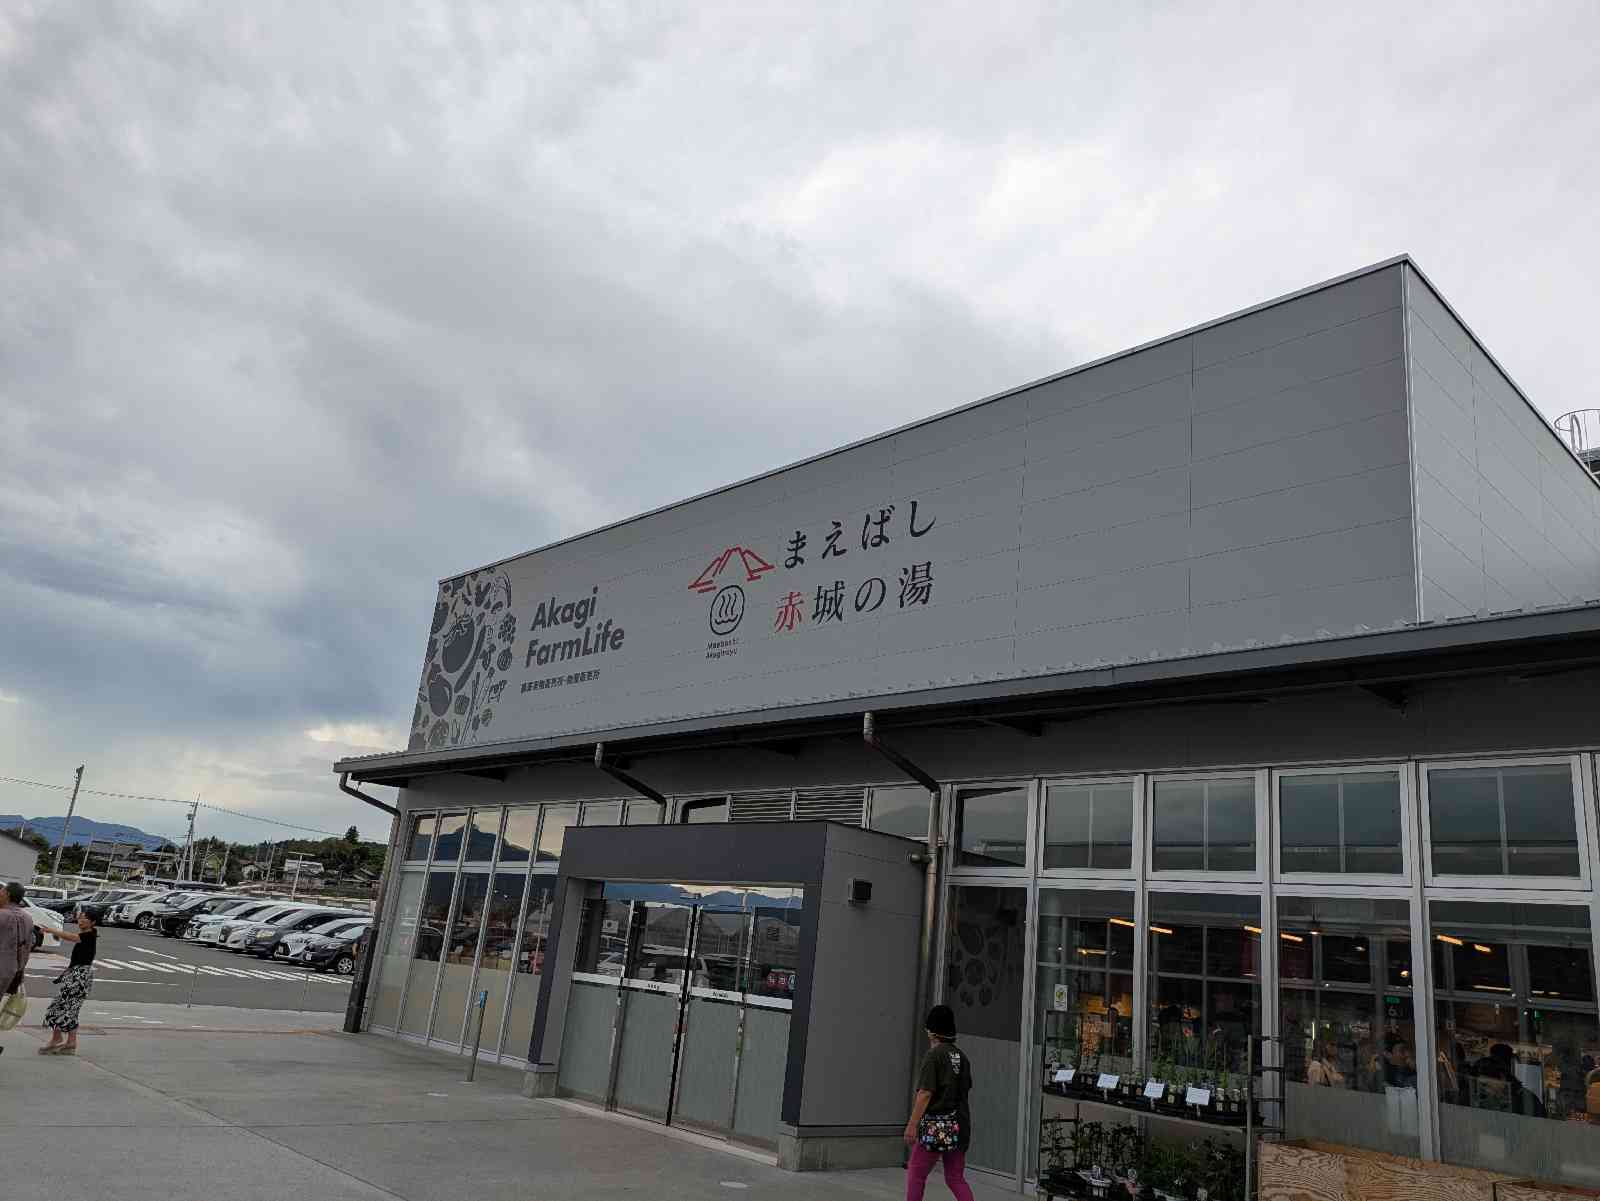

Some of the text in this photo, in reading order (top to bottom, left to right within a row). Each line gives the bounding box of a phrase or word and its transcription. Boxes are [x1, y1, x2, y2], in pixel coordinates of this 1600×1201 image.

[785, 500, 936, 569] まえばし
[530, 585, 599, 631] Akagi
[774, 560, 935, 634] 赤城の湯
[525, 618, 625, 669] FarmLife
